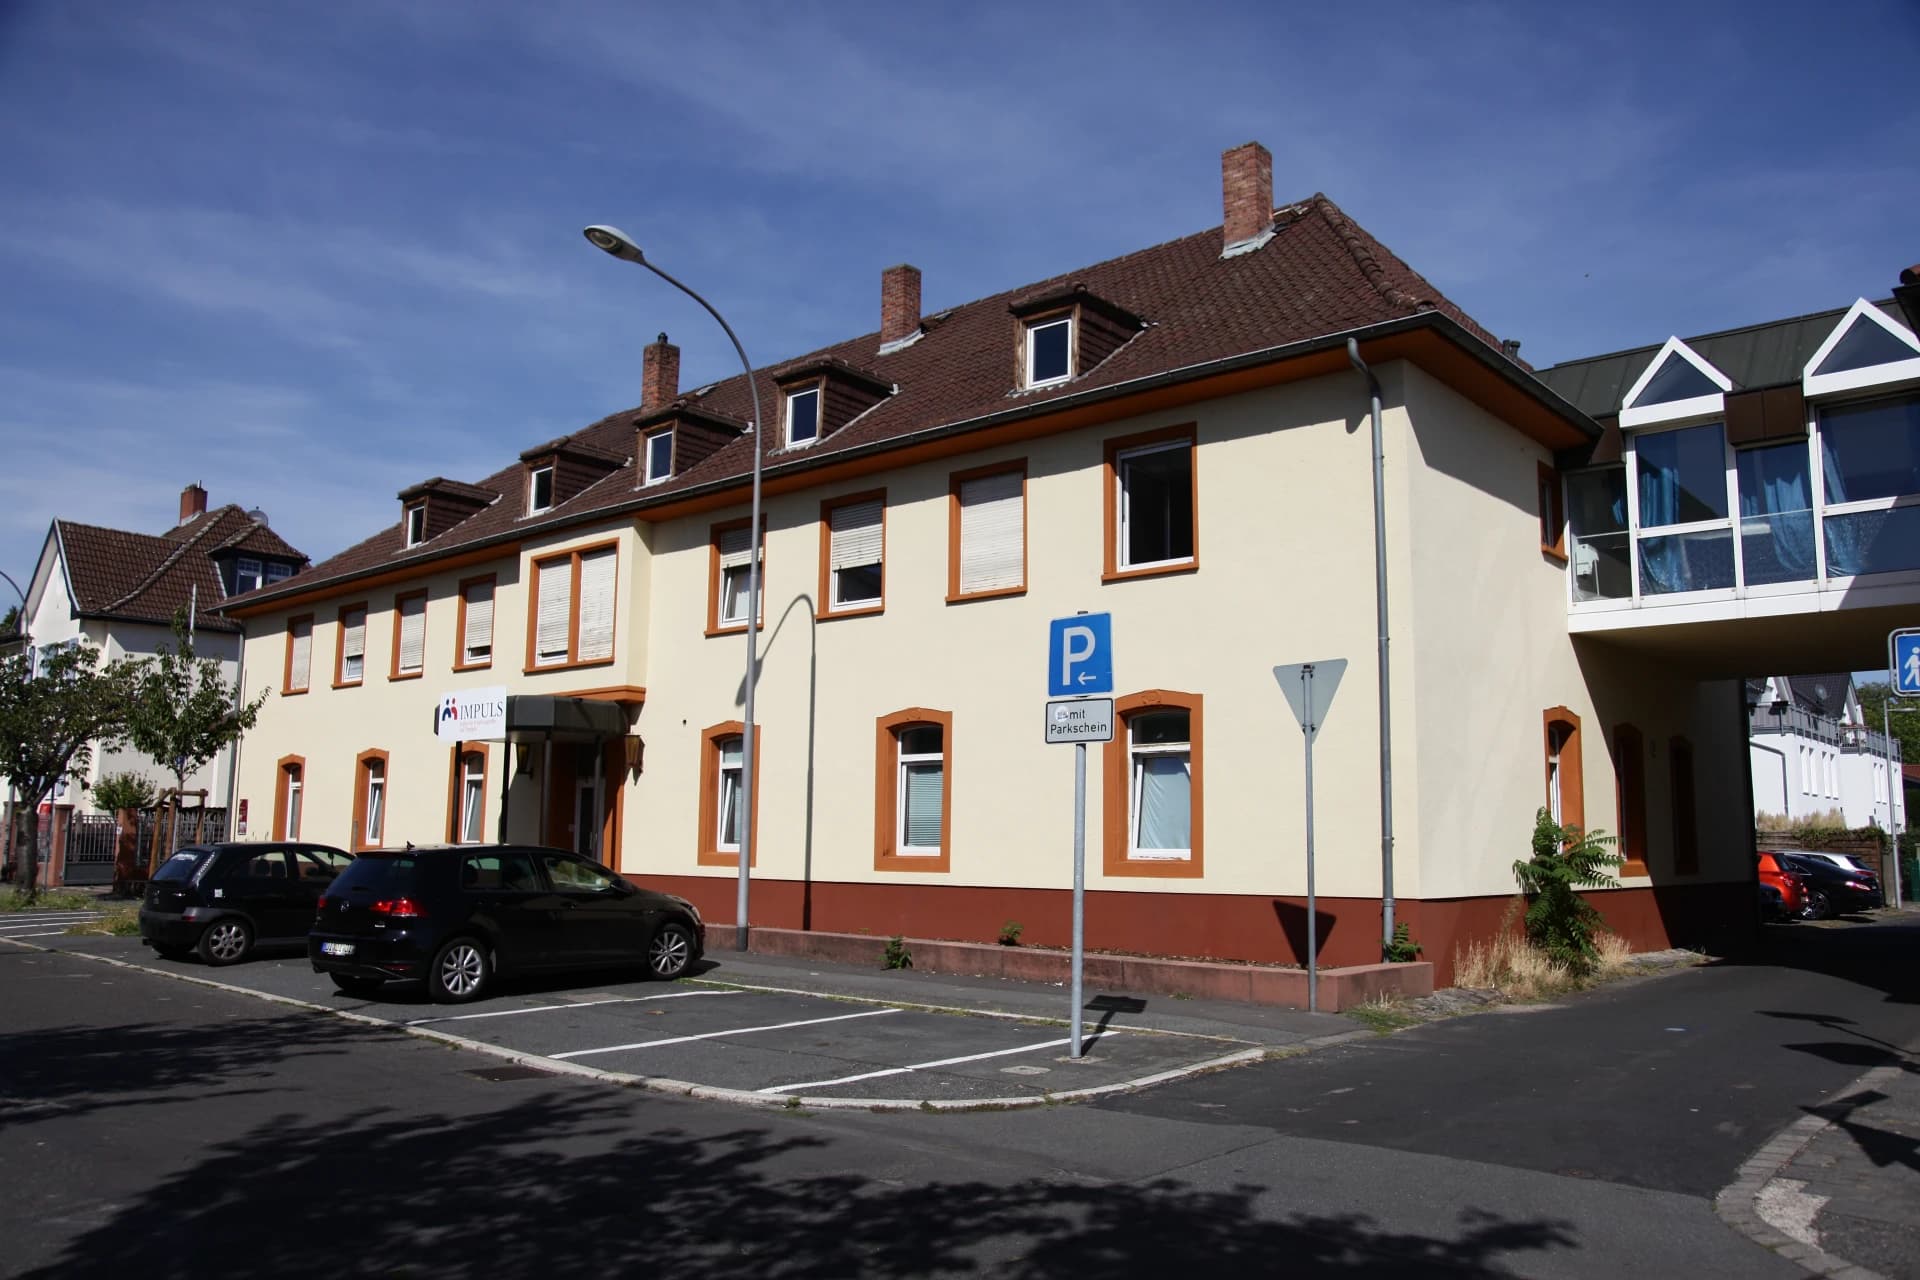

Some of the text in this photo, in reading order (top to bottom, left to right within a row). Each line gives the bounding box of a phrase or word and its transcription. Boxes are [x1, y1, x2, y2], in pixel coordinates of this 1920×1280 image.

[1062, 626, 1096, 686] P
[460, 701, 503, 720] IMPULS
[1069, 708, 1086, 720] mit
[1050, 721, 1107, 735] Parkschein
